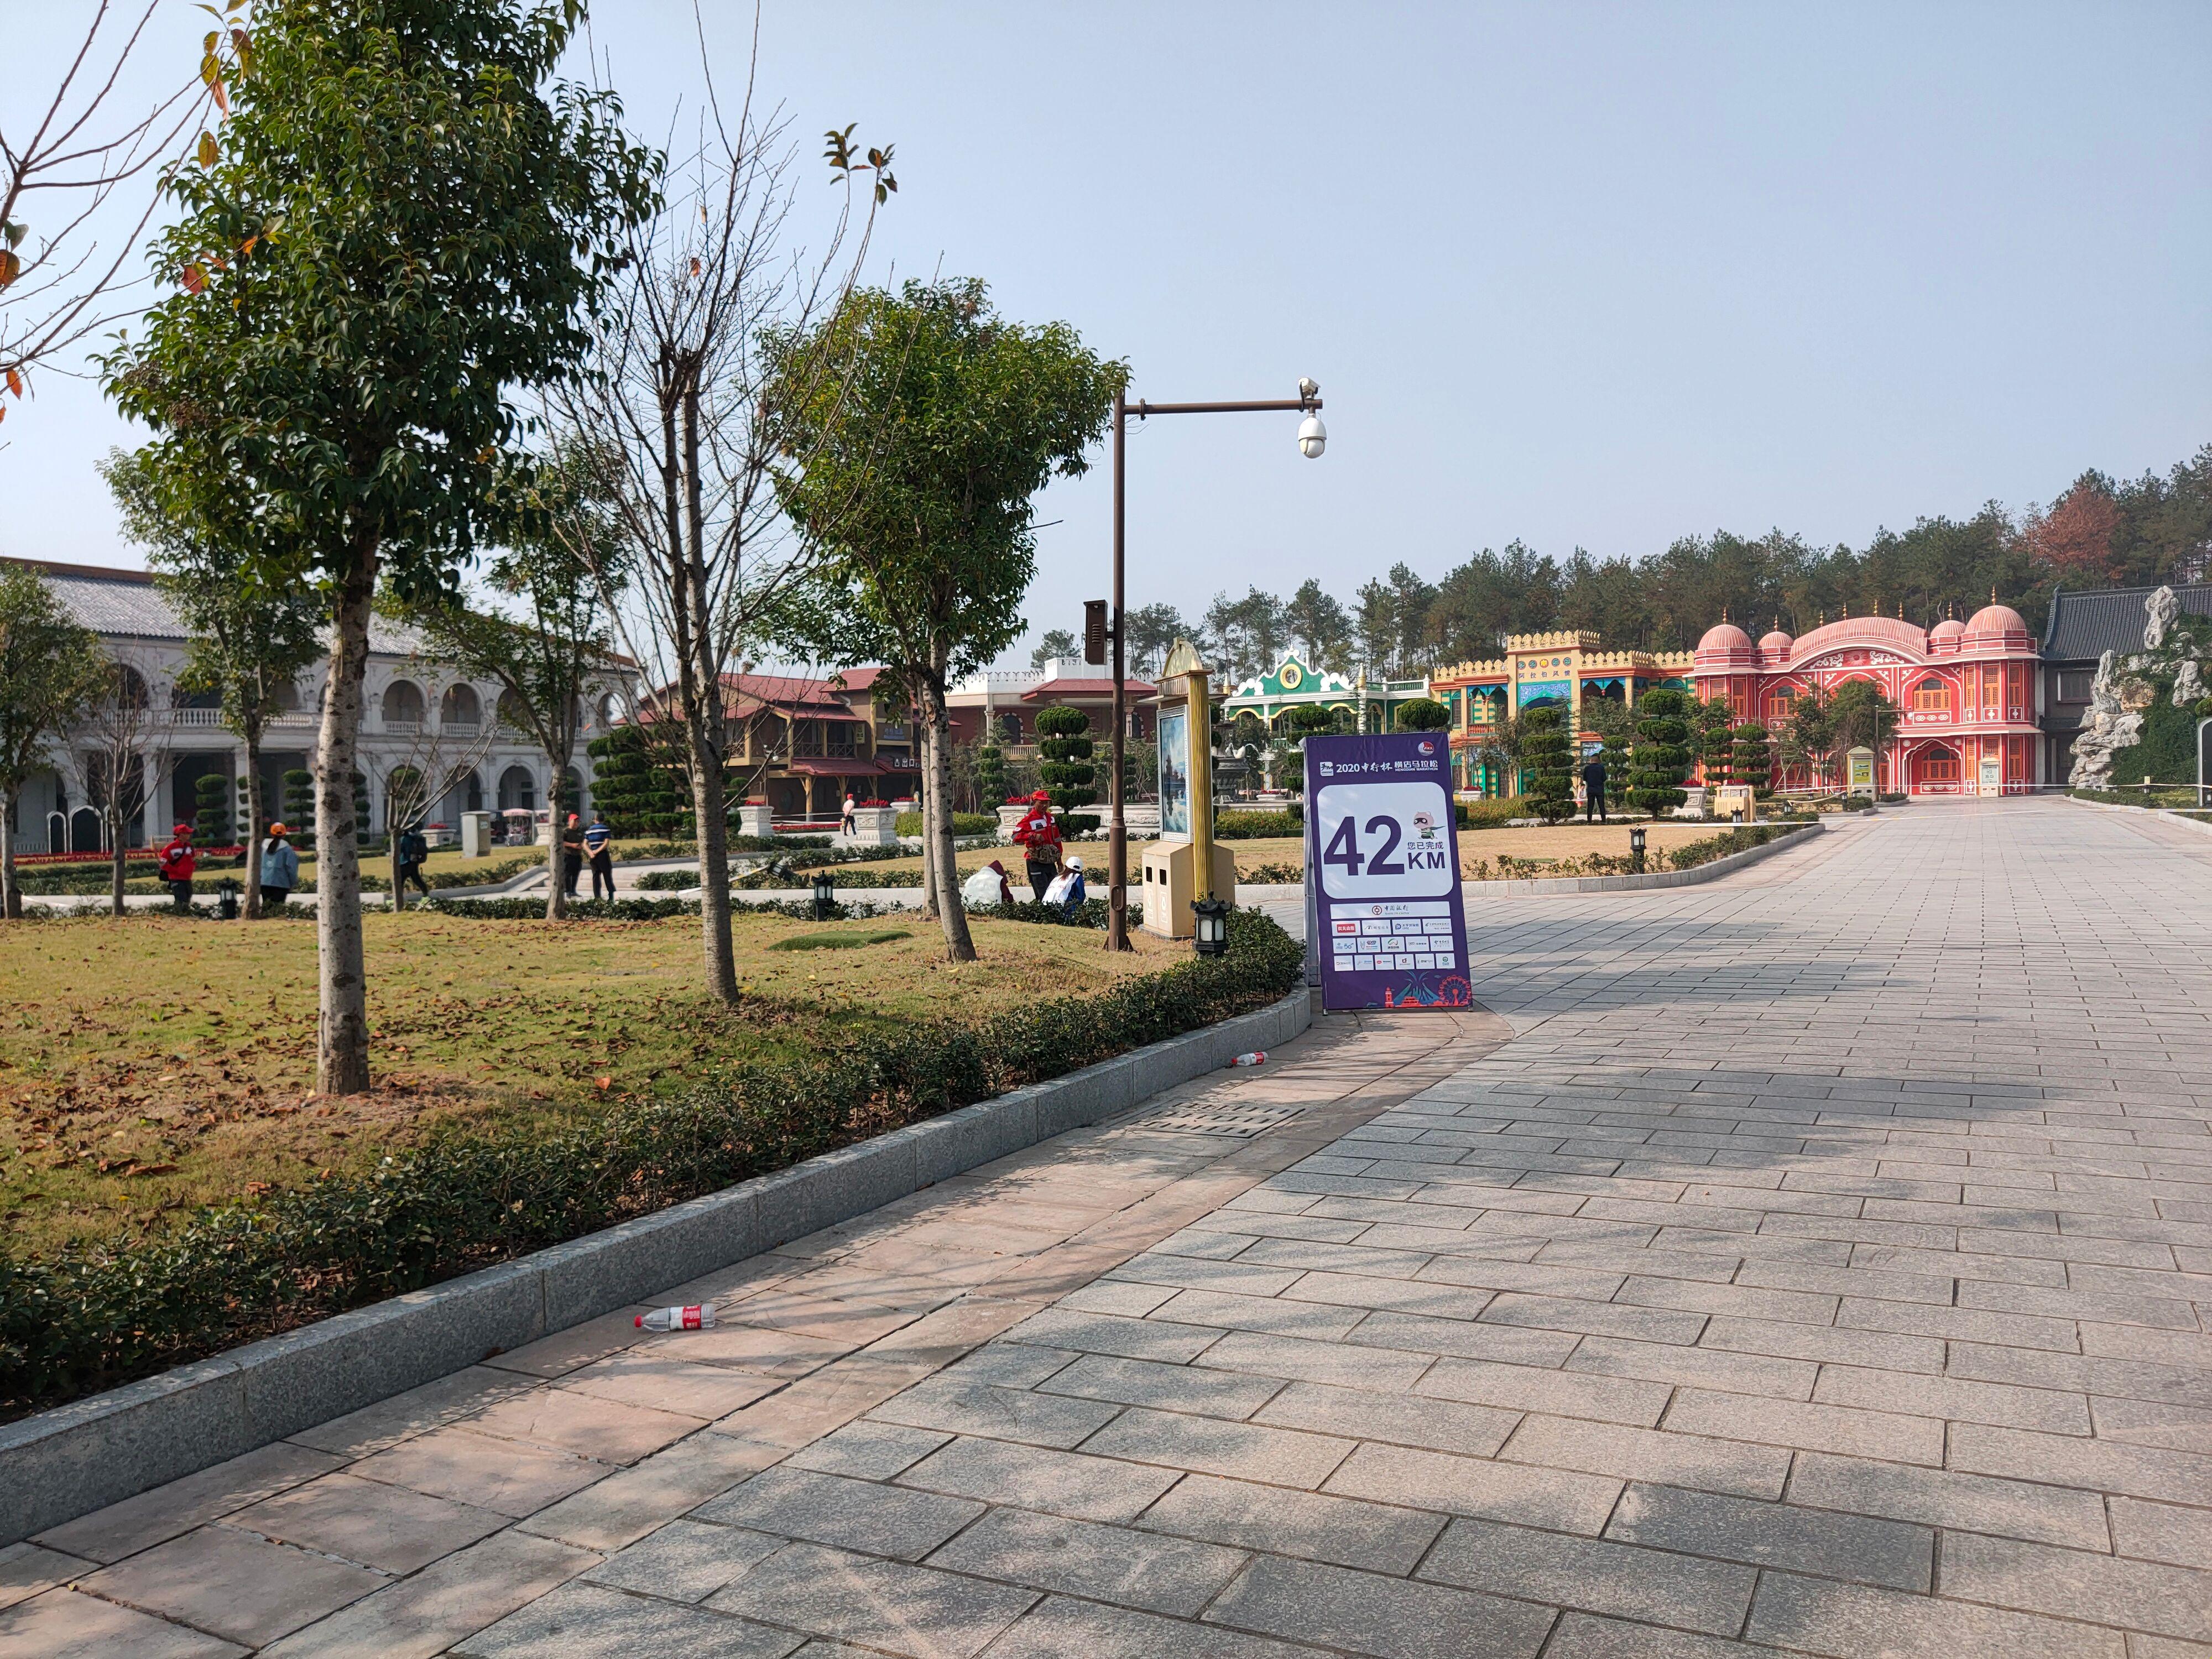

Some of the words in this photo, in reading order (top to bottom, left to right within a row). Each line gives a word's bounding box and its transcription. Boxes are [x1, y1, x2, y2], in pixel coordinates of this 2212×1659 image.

[901, 757, 915, 768] 出口
[1336, 764, 1360, 773] 2020
[1323, 815, 1405, 875] 42
[1407, 842, 1444, 850] 您已完成
[1408, 852, 1446, 869] KM
